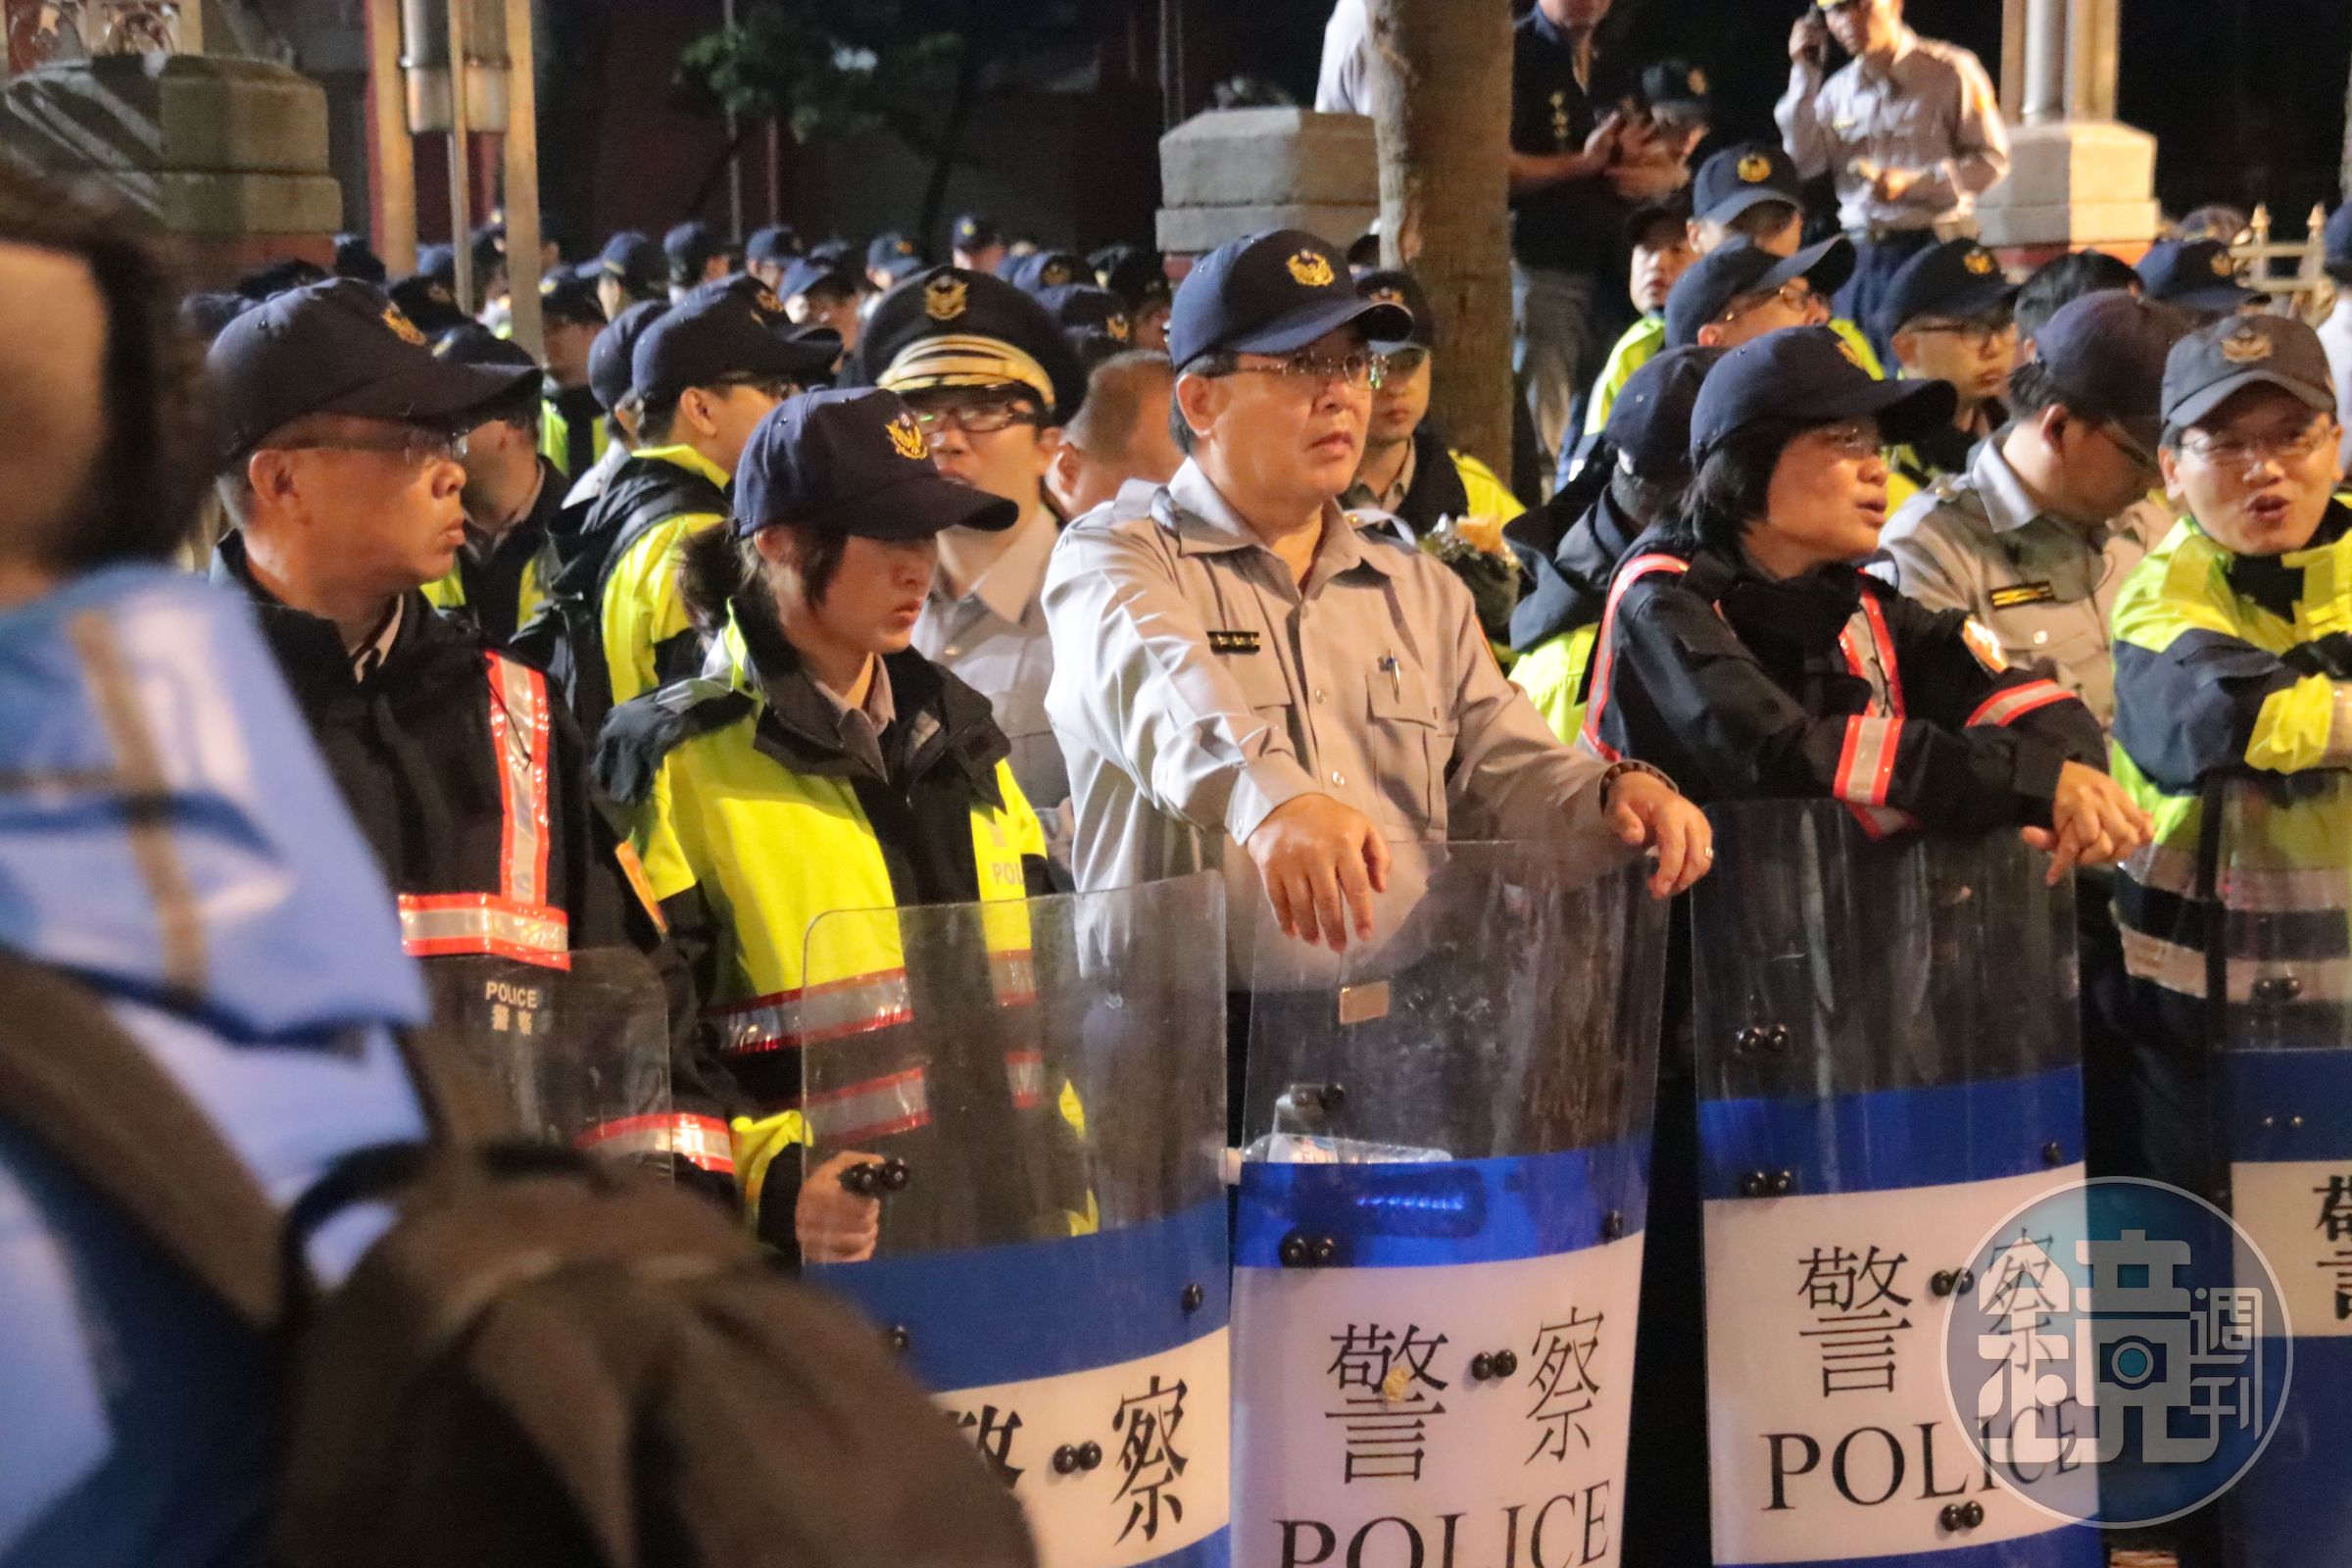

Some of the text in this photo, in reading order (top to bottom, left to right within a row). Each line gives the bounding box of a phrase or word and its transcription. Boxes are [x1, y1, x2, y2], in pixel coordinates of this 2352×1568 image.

[485, 981, 538, 1008] POLICE
[1325, 1306, 1605, 1484] 警察
[1760, 1396, 2082, 1511] POLICE
